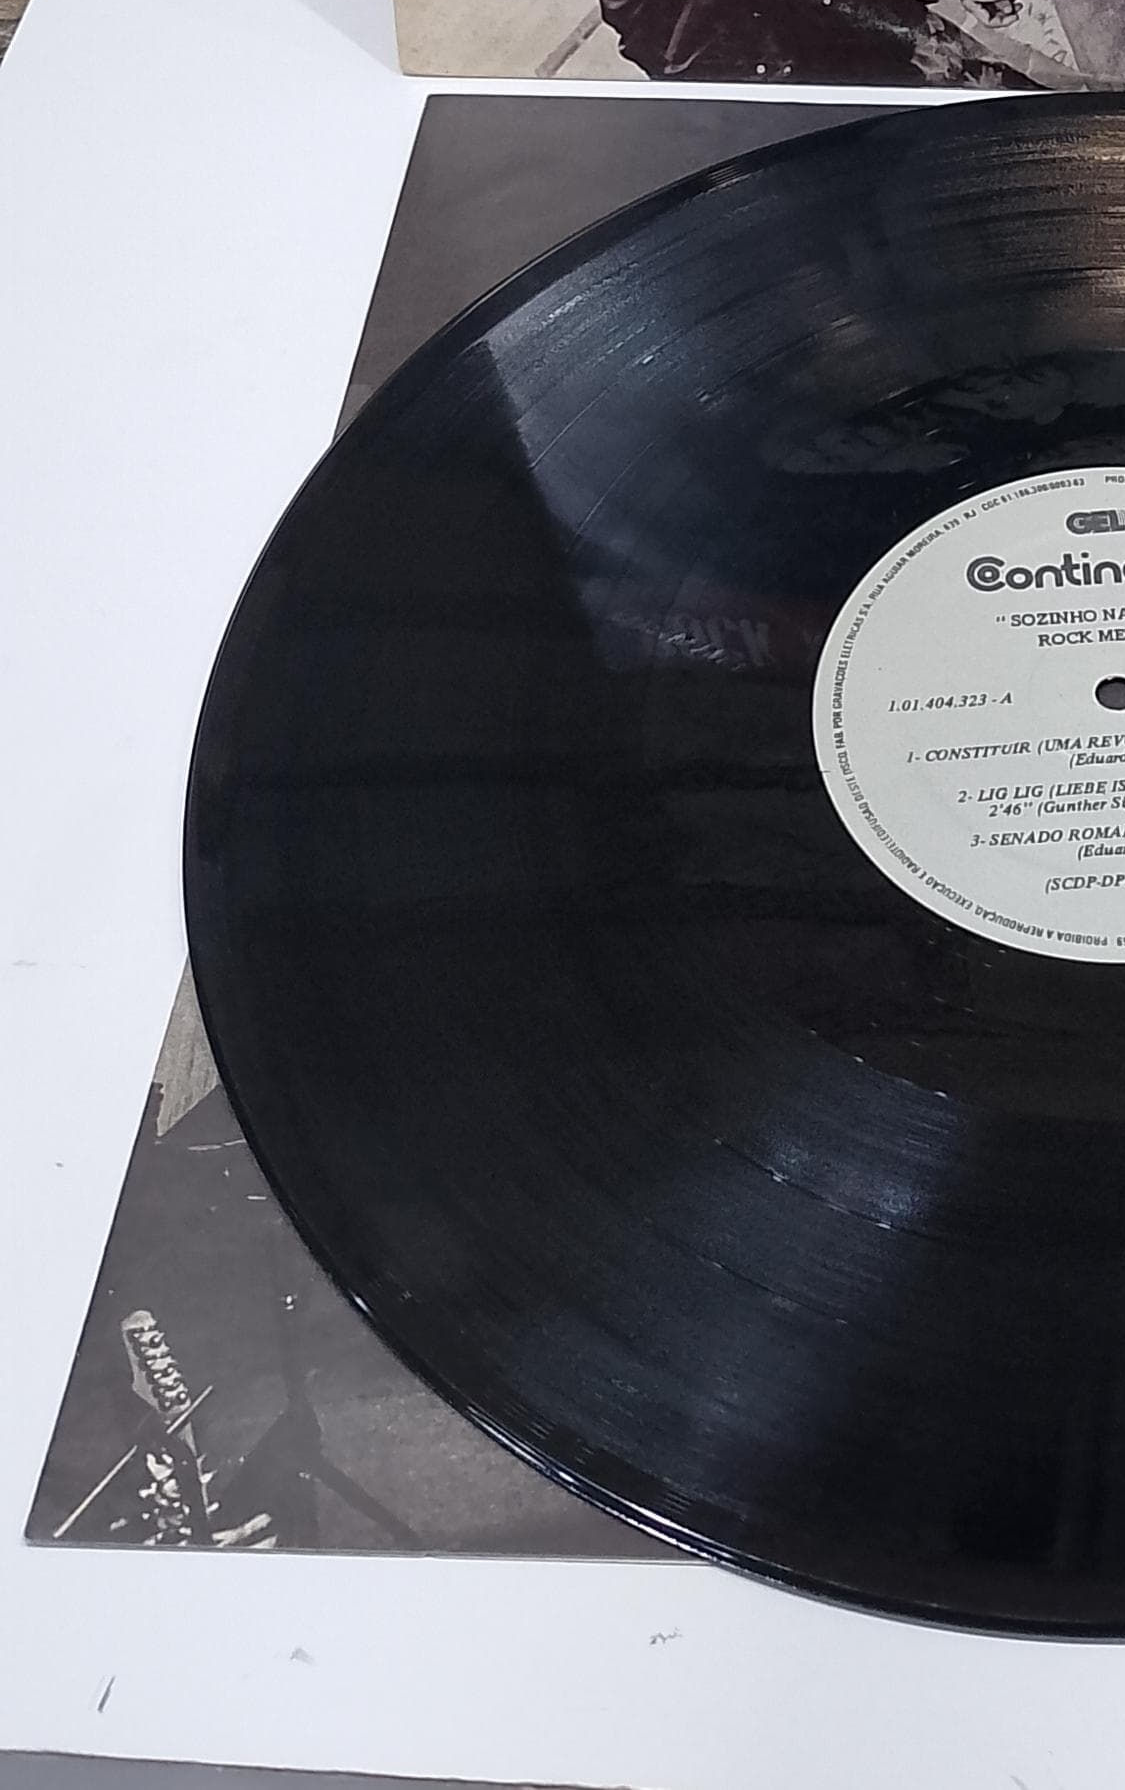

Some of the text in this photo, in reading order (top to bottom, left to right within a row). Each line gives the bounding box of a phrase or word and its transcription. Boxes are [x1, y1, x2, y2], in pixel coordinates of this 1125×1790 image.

[832, 710, 843, 730] POR
[868, 584, 886, 601] RUA
[980, 498, 1001, 511] CGC
[1038, 631, 1094, 648] ROCK
[888, 693, 988, 712] 1.01.404.323
[1000, 692, 1013, 704] A
[925, 741, 1032, 763] CONSTITUIR
[1037, 736, 1082, 755] (UMA
[957, 790, 973, 803] 2-
[976, 787, 1008, 802] LIG
[1013, 785, 1044, 800] LIG
[1050, 780, 1108, 800] (LIEBE
[1037, 799, 1108, 817] (Gunther
[970, 834, 986, 847] 3-
[989, 829, 1064, 847] SENADO
